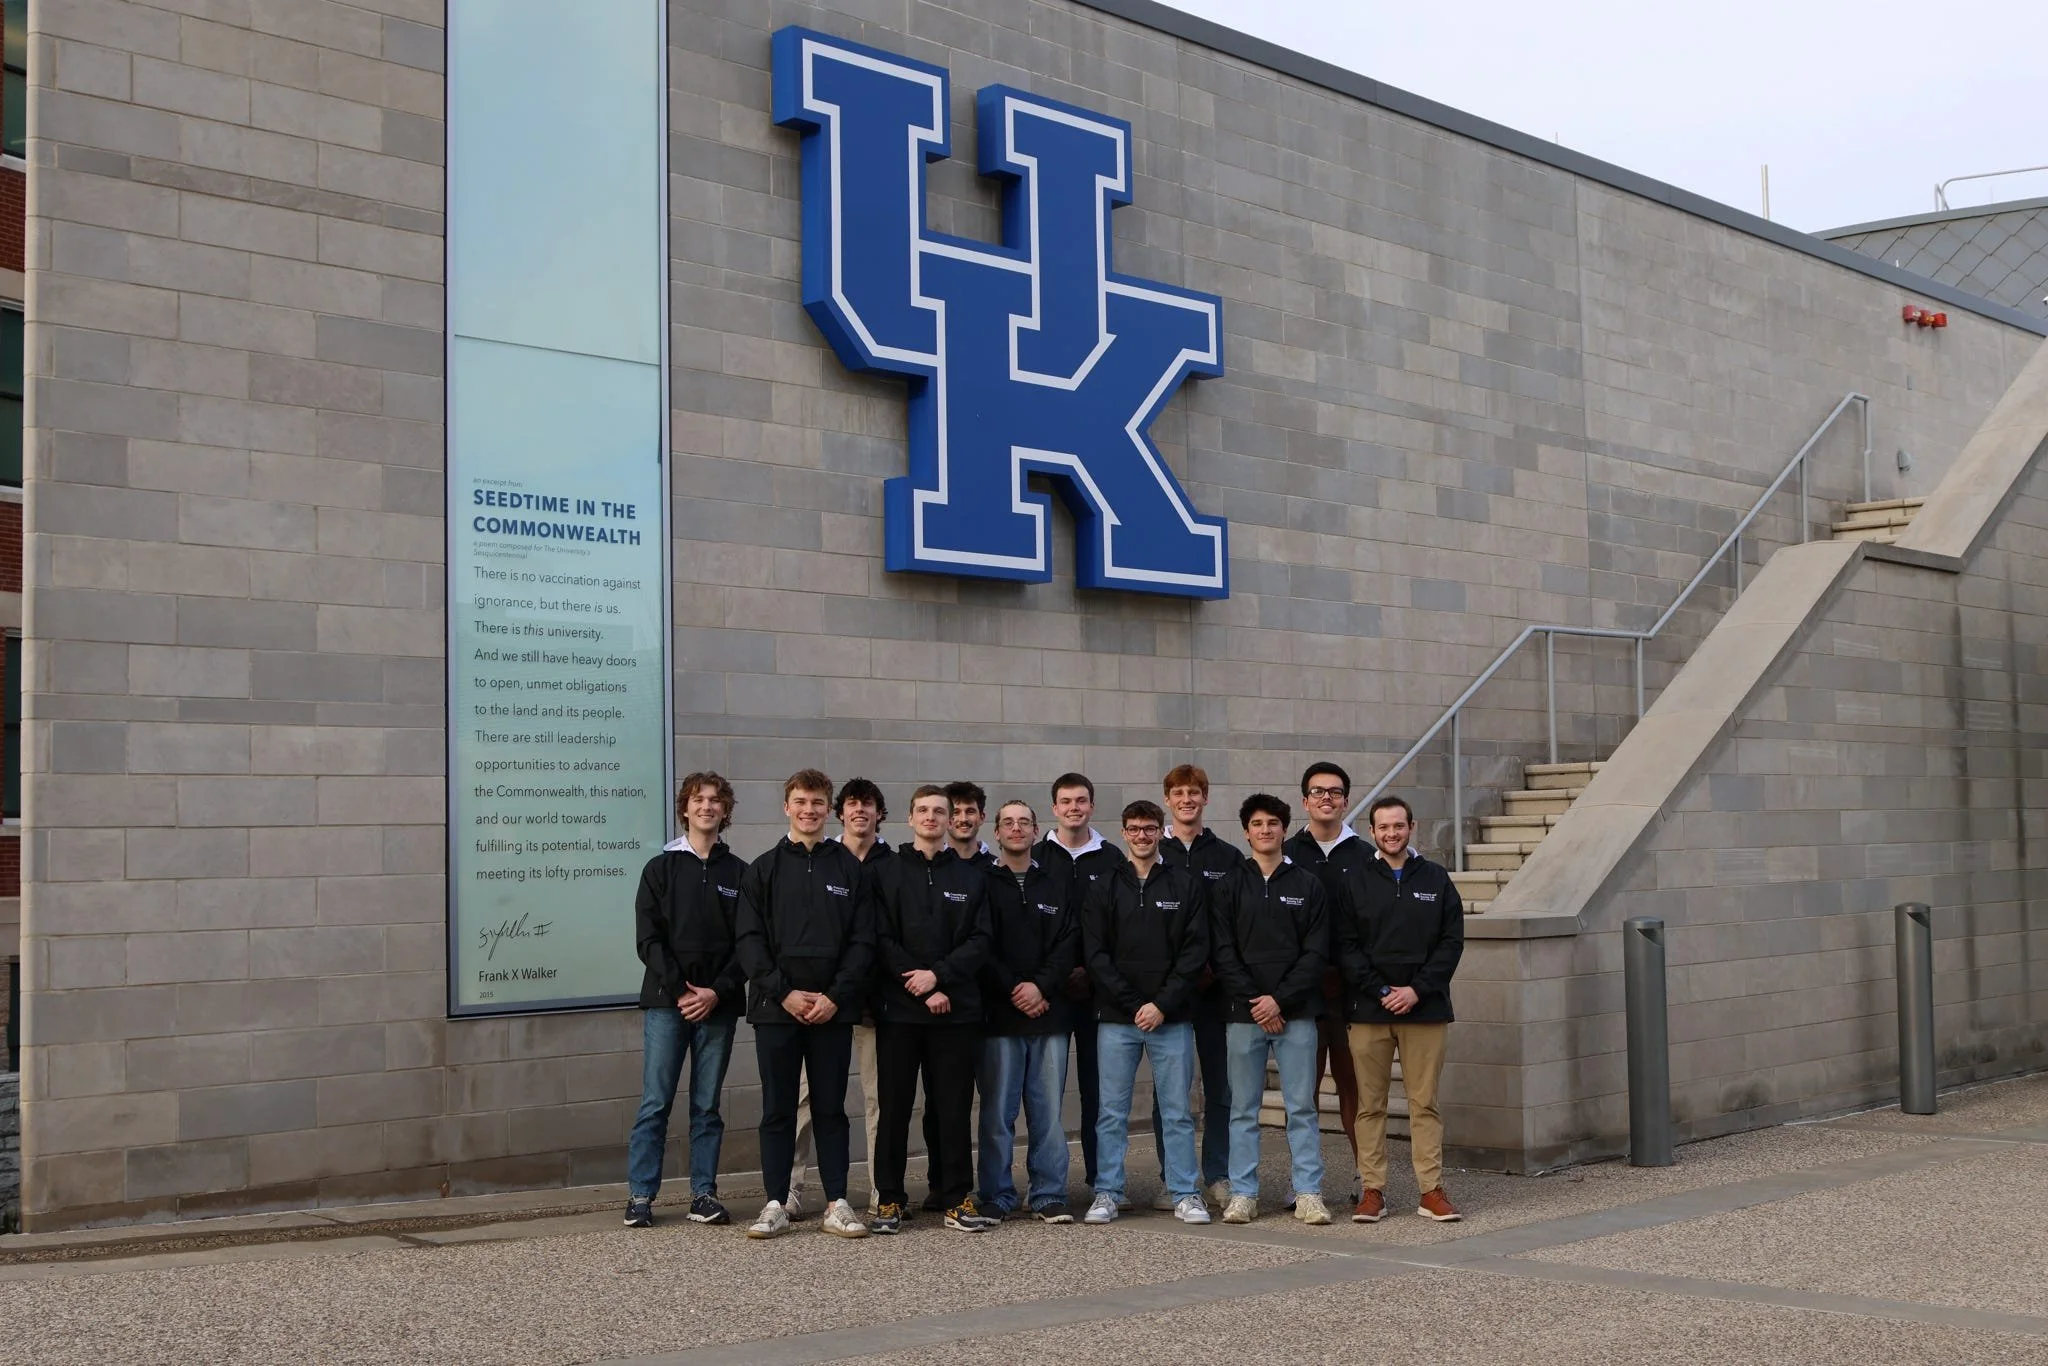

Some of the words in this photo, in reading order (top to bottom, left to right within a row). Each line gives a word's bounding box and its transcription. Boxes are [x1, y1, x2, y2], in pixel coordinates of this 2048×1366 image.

[772, 25, 1229, 599] UK
[474, 489, 569, 513] SEEDTIME
[577, 499, 595, 516] IN
[601, 502, 635, 519] THE
[473, 516, 641, 545] COMMONWEALTH
[474, 566, 506, 580] There
[511, 569, 518, 582] is
[522, 573, 536, 583] no
[539, 573, 600, 587] vaccination
[603, 578, 640, 592] against
[474, 594, 536, 611] ignorance,
[540, 597, 558, 610] but
[562, 599, 591, 612] there
[595, 602, 603, 613] is
[606, 606, 621, 615] us.
[474, 621, 508, 634] There
[512, 623, 520, 636] is
[524, 624, 544, 636] this
[548, 625, 603, 642] university.
[474, 648, 498, 661] And
[502, 653, 518, 661] we
[520, 650, 539, 662] still
[543, 651, 568, 664] have
[572, 652, 603, 668] heavy
[606, 654, 636, 667] doors
[475, 677, 486, 687] to
[490, 680, 523, 692] open,
[527, 680, 563, 690] unmet
[566, 678, 627, 694] obligations
[475, 704, 487, 716] to
[490, 703, 509, 715] the
[513, 704, 538, 717] land
[542, 705, 563, 718] and
[567, 706, 579, 717] its
[583, 706, 624, 720] people.
[475, 730, 508, 742] There
[513, 735, 530, 743] are
[535, 731, 553, 743] still
[558, 732, 616, 748] leadership
[476, 759, 555, 773] opportunities
[558, 761, 570, 770] to
[573, 759, 620, 771] advance
[474, 785, 493, 797] the
[497, 785, 587, 799] Commonwealth,
[590, 785, 608, 797] this
[612, 786, 646, 799] nation,
[475, 812, 498, 824] and
[502, 816, 522, 824] our
[526, 812, 558, 824] world
[561, 812, 606, 824] towards
[476, 839, 522, 855] fulfilling
[526, 840, 538, 852] its
[542, 838, 594, 854] potential,
[598, 838, 640, 850] towards
[477, 867, 525, 882] meeting
[530, 867, 542, 878] its
[546, 865, 569, 880] lofty
[574, 864, 626, 880] promises.
[479, 969, 509, 982] Frank
[512, 969, 518, 980] X
[521, 967, 557, 979] Walker
[480, 992, 493, 1000] 2015
